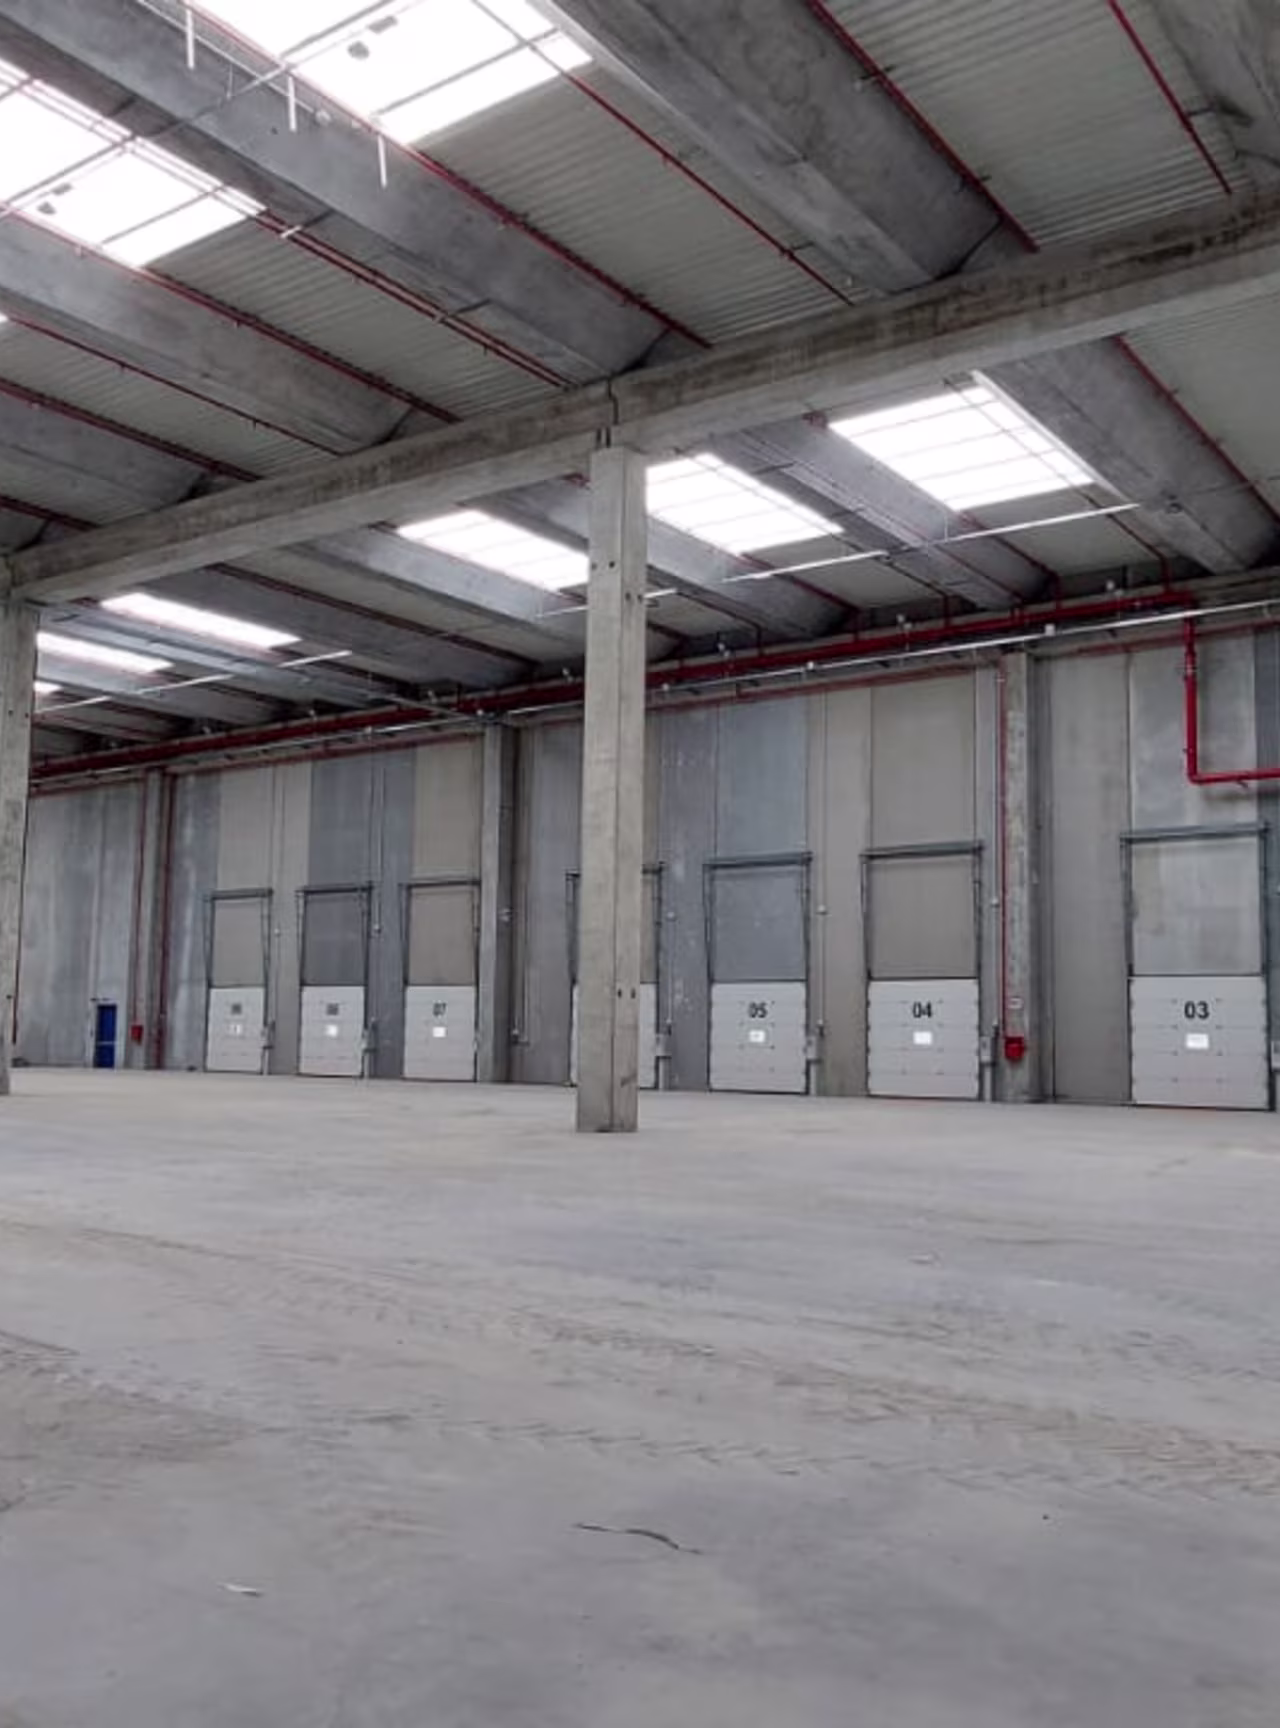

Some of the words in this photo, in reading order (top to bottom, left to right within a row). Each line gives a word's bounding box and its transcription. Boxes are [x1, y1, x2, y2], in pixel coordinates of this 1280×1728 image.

[749, 1002, 768, 1018] 05
[912, 1002, 932, 1019] 04
[1184, 1001, 1209, 1019] 03
